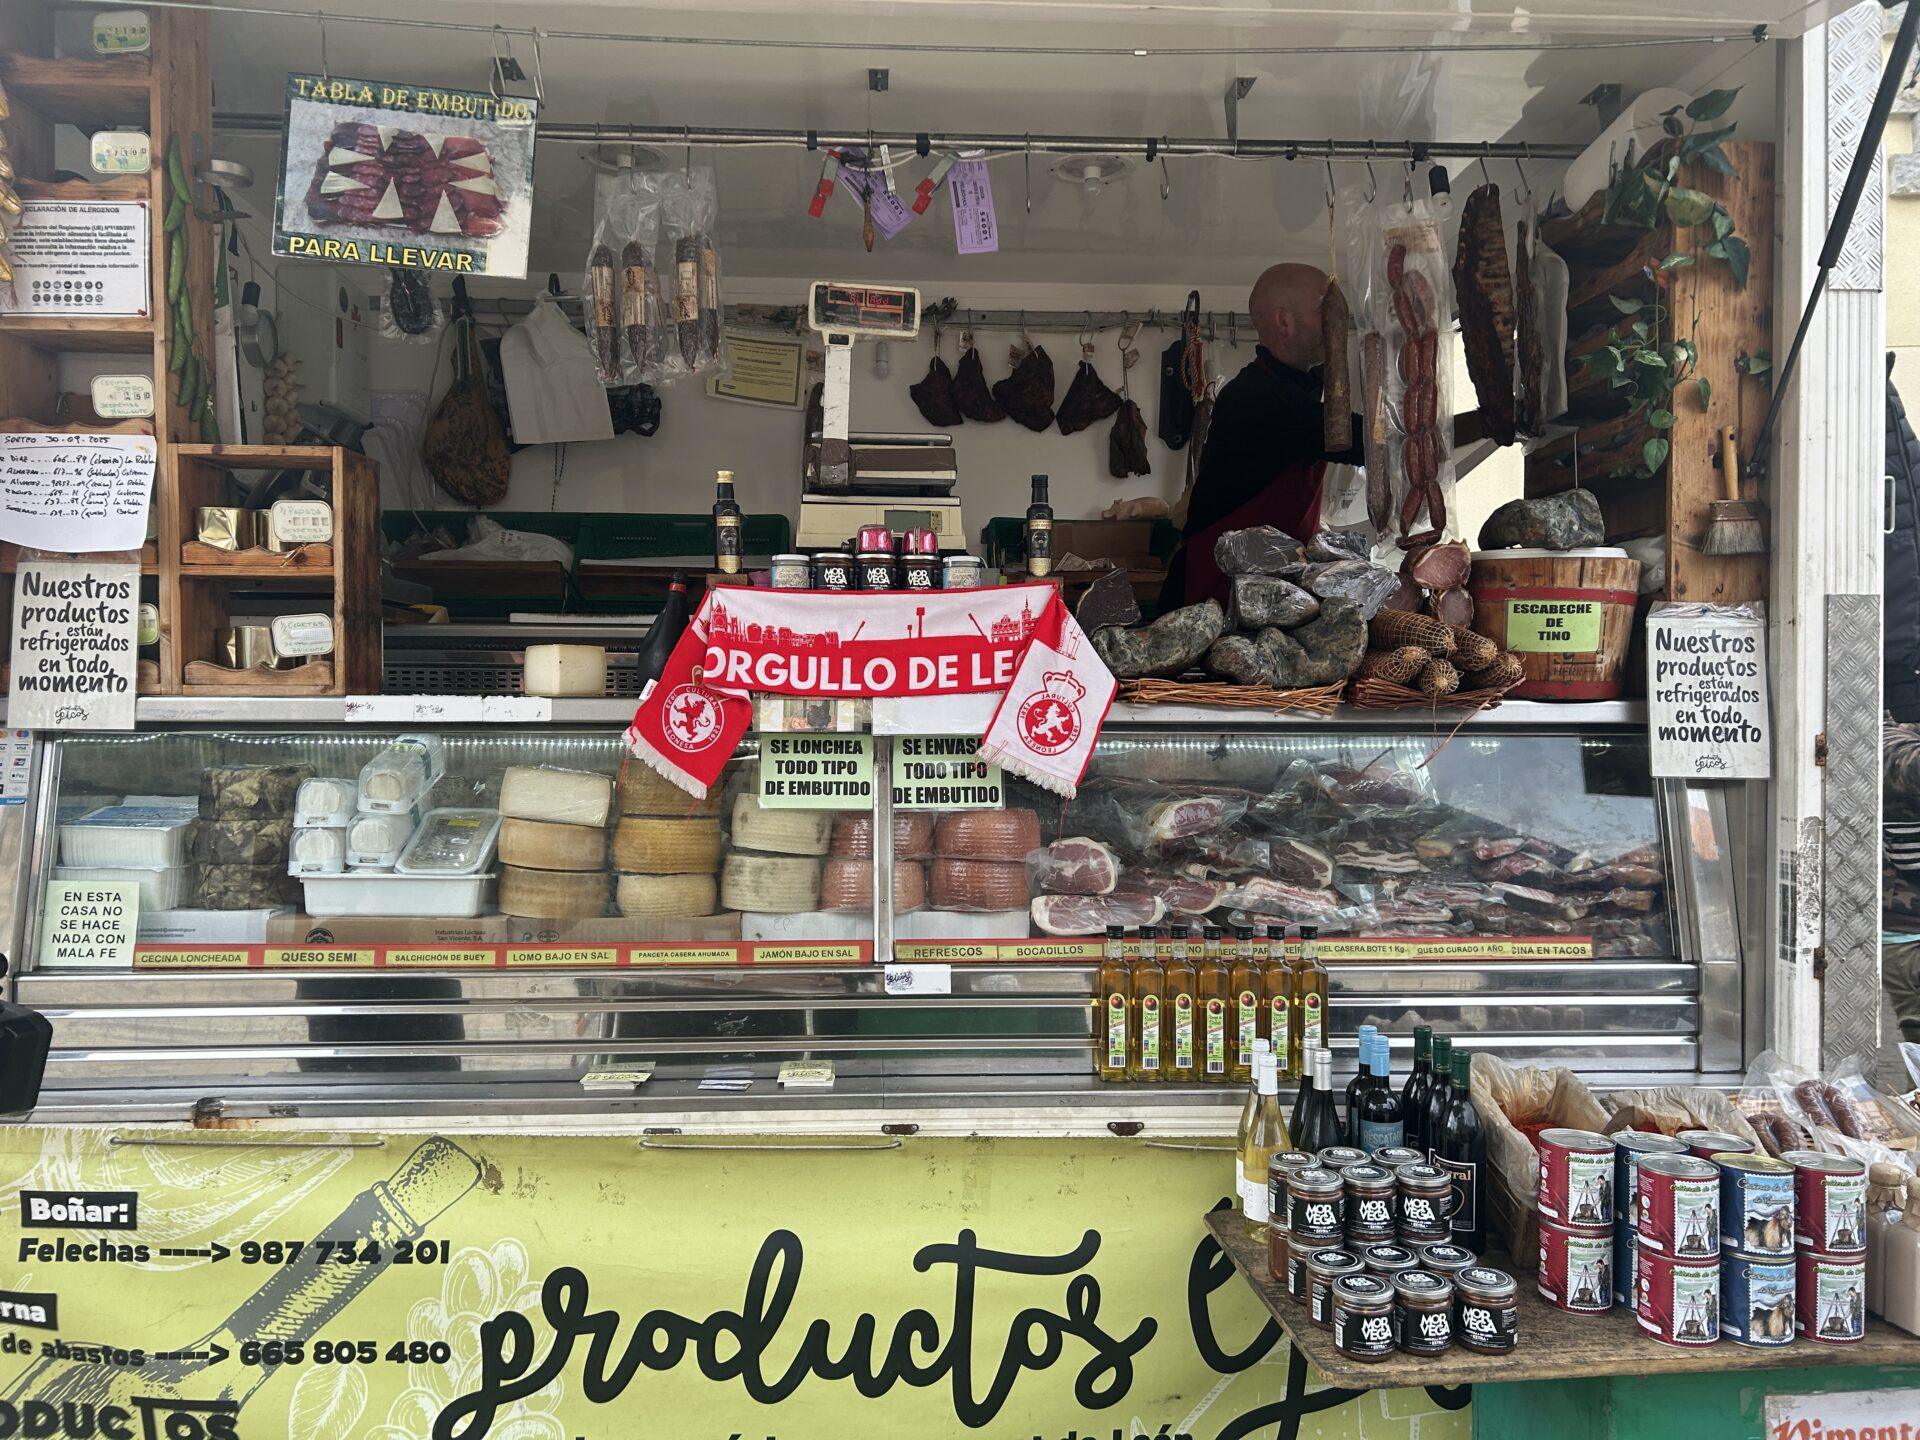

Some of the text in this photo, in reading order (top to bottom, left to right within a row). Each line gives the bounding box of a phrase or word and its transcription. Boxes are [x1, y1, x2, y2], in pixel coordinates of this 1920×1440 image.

[294, 78, 528, 120] TABLA DE EMBUTIDO
[24, 206, 66, 214] ECLARACIÓN
[288, 236, 474, 272] PARA LLEVAR
[22, 571, 130, 600] Nuestros
[824, 574, 848, 585] VEGA
[866, 574, 890, 585] VEGA
[908, 576, 932, 587] VEGA
[20, 600, 130, 630] productos
[1512, 603, 1592, 614] ESCABECHE
[1546, 617, 1564, 628] DE
[66, 622, 104, 638] están
[1537, 630, 1571, 642] TINO
[20, 630, 130, 656] refrigerados
[1655, 627, 1756, 654] Nuestros
[38, 653, 108, 674] en todo
[703, 646, 1018, 692] ORGULLO DE LE
[1656, 656, 1758, 682] productos
[18, 666, 128, 694] momento
[1698, 676, 1734, 690] están
[685, 686, 720, 712] CULTURAL
[1656, 682, 1760, 708] refrigerados
[1675, 704, 1742, 724] en todo
[664, 724, 694, 750] LEONESA
[1658, 716, 1762, 744] momento
[770, 738, 864, 755] SE LONCHEA
[902, 738, 922, 756] SE
[775, 759, 858, 776] TODO TIPO
[903, 762, 988, 780] TODO TIPO
[765, 780, 870, 796] DE EMBUTIDO
[892, 786, 1000, 804] DE EMBUTIDO
[64, 891, 122, 902] EN ESTA
[60, 905, 123, 917] CASA NO
[59, 919, 120, 932] SE HACE
[52, 933, 126, 946] NADA CON
[56, 947, 118, 959] MALA FE
[638, 950, 730, 959] PANCETA CASERA AHUMADA
[760, 948, 854, 960] JAMÓN BAJO EN SAL
[914, 946, 984, 958] REFRESCOS
[1016, 945, 1084, 956] BOCADILLOS
[1317, 945, 1334, 954] MIEL
[1334, 944, 1366, 953] CASERA
[1367, 944, 1388, 952] BOTE
[1417, 946, 1444, 954] QUESO
[1446, 944, 1479, 954] CURADO
[1486, 943, 1504, 954] AÑO
[1512, 945, 1587, 955] CINA EN TACOS
[140, 952, 242, 964] CECINA LONCHEADA
[280, 951, 357, 963] QUESO SEMI
[394, 952, 486, 963] SALCHICHÓN DE BUEY
[512, 951, 610, 962] LOMO BAJO EN SAL
[30, 1196, 129, 1223] Boñar:
[1306, 1204, 1332, 1215] MOR
[1360, 1200, 1386, 1212] MOR
[1404, 1196, 1430, 1210] MOR
[1306, 1212, 1337, 1225] VEGA
[1359, 1208, 1390, 1221] VEGA
[1404, 1206, 1436, 1220] VEGA
[18, 1238, 450, 1265] Felechas 987 734 201
[0, 1302, 47, 1324] rna
[1420, 1313, 1447, 1326] MOR
[1464, 1305, 1490, 1320] MOR
[1362, 1316, 1388, 1328] MOR
[1462, 1316, 1498, 1334] VEGA
[432, 1228, 1158, 1440] productos
[1360, 1325, 1392, 1341] VEGA
[1420, 1322, 1450, 1339] VEGA
[0, 1332, 452, 1367] de abastos 665 805 480
